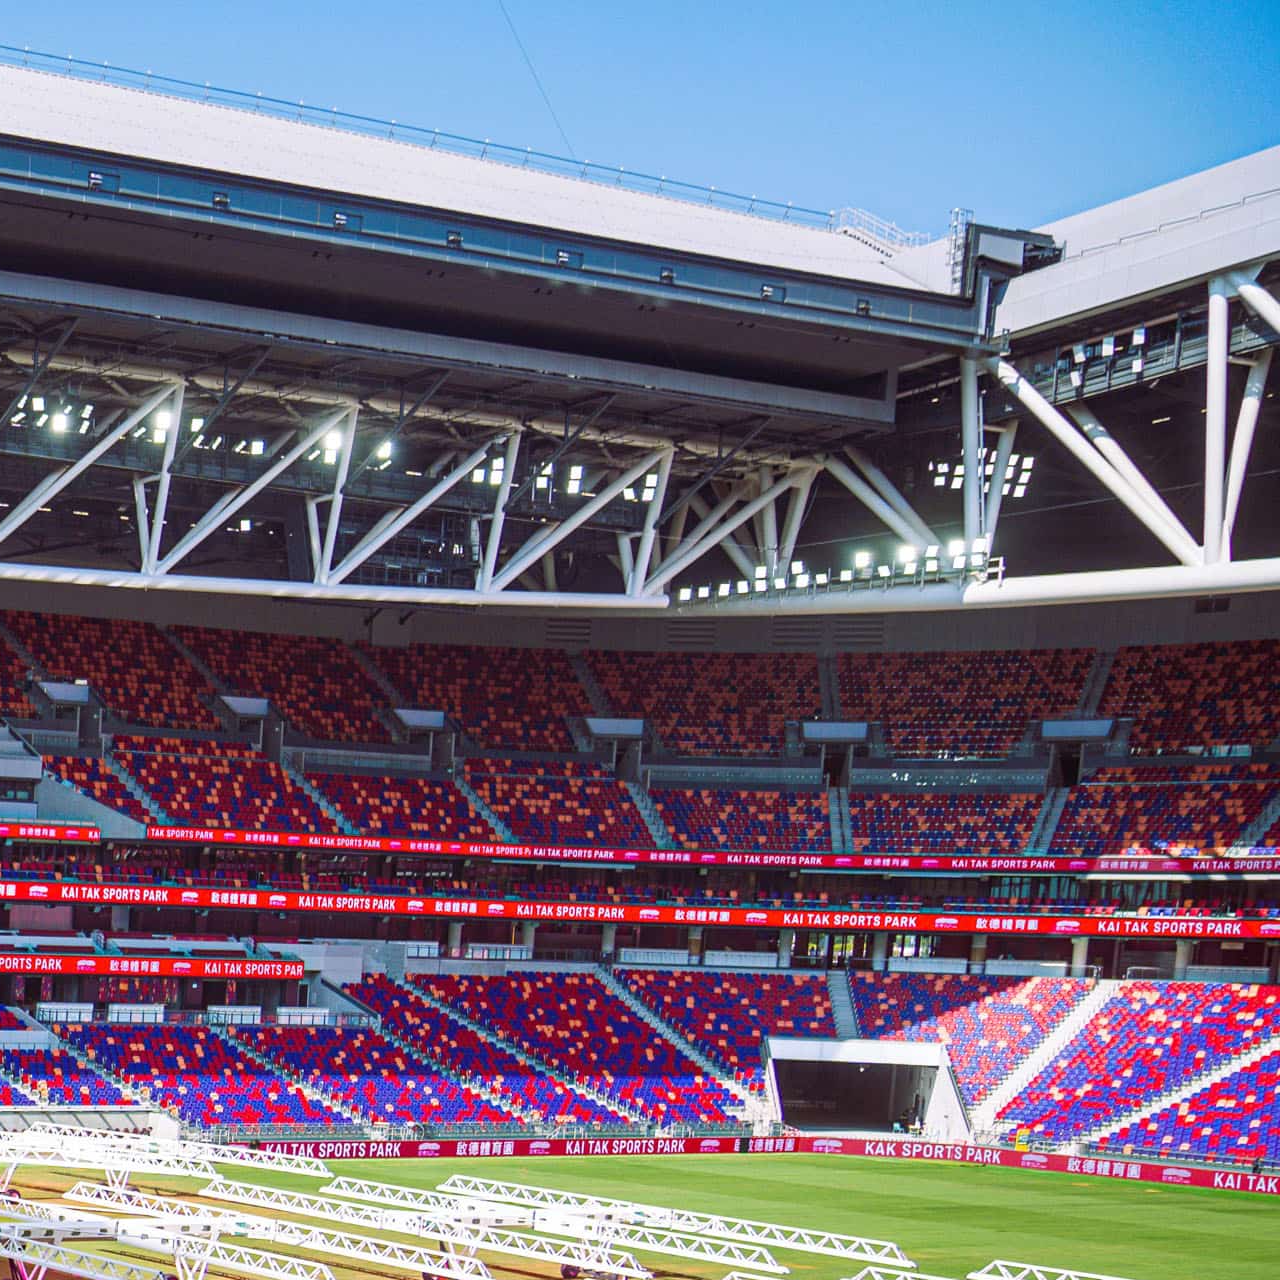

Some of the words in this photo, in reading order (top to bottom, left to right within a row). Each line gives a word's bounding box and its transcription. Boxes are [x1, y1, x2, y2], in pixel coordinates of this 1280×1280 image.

[726, 854, 742, 863] KAI
[743, 854, 760, 864] TAK
[762, 854, 796, 865] SPORTS
[798, 855, 822, 865] PARK
[951, 858, 968, 868] KAI
[970, 858, 988, 868] TAK
[991, 859, 1028, 869] SPORTS
[1029, 859, 1055, 869] PARK
[60, 885, 79, 899] KAI
[80, 886, 100, 899] TAK
[102, 886, 140, 901] SPORTS
[142, 888, 168, 902] PARK
[298, 895, 314, 907] KAI
[316, 895, 334, 908] TAK
[335, 896, 371, 909] SPORTS
[371, 897, 395, 910] PARK
[516, 903, 533, 916] KAI
[535, 904, 553, 916] TAK
[555, 904, 595, 918] SPORTS
[597, 906, 625, 919] PARK
[783, 912, 803, 925] KAI
[806, 912, 830, 925] TAK
[833, 913, 881, 927] SPORTS
[884, 914, 917, 927] PARK
[1097, 920, 1120, 932] KAI
[1124, 920, 1148, 933] TAK
[1152, 920, 1203, 934] SPORTS
[1206, 921, 1241, 935] PARK
[34, 957, 62, 970] PARK
[204, 961, 221, 974] KAI
[223, 961, 242, 975] TAK
[244, 962, 282, 976] SPORTS
[291, 1142, 315, 1158] TAK
[319, 1141, 366, 1159] SPORTS
[368, 1141, 401, 1158] PARK
[565, 1139, 585, 1155] KAI
[588, 1139, 609, 1155] TAK
[611, 1139, 654, 1154] SPORTS
[657, 1138, 686, 1153] PARK
[901, 1142, 963, 1161] SPORTS
[965, 1147, 1002, 1165] PARK
[1213, 1171, 1241, 1190] KAI
[1246, 1174, 1279, 1194] TAK
